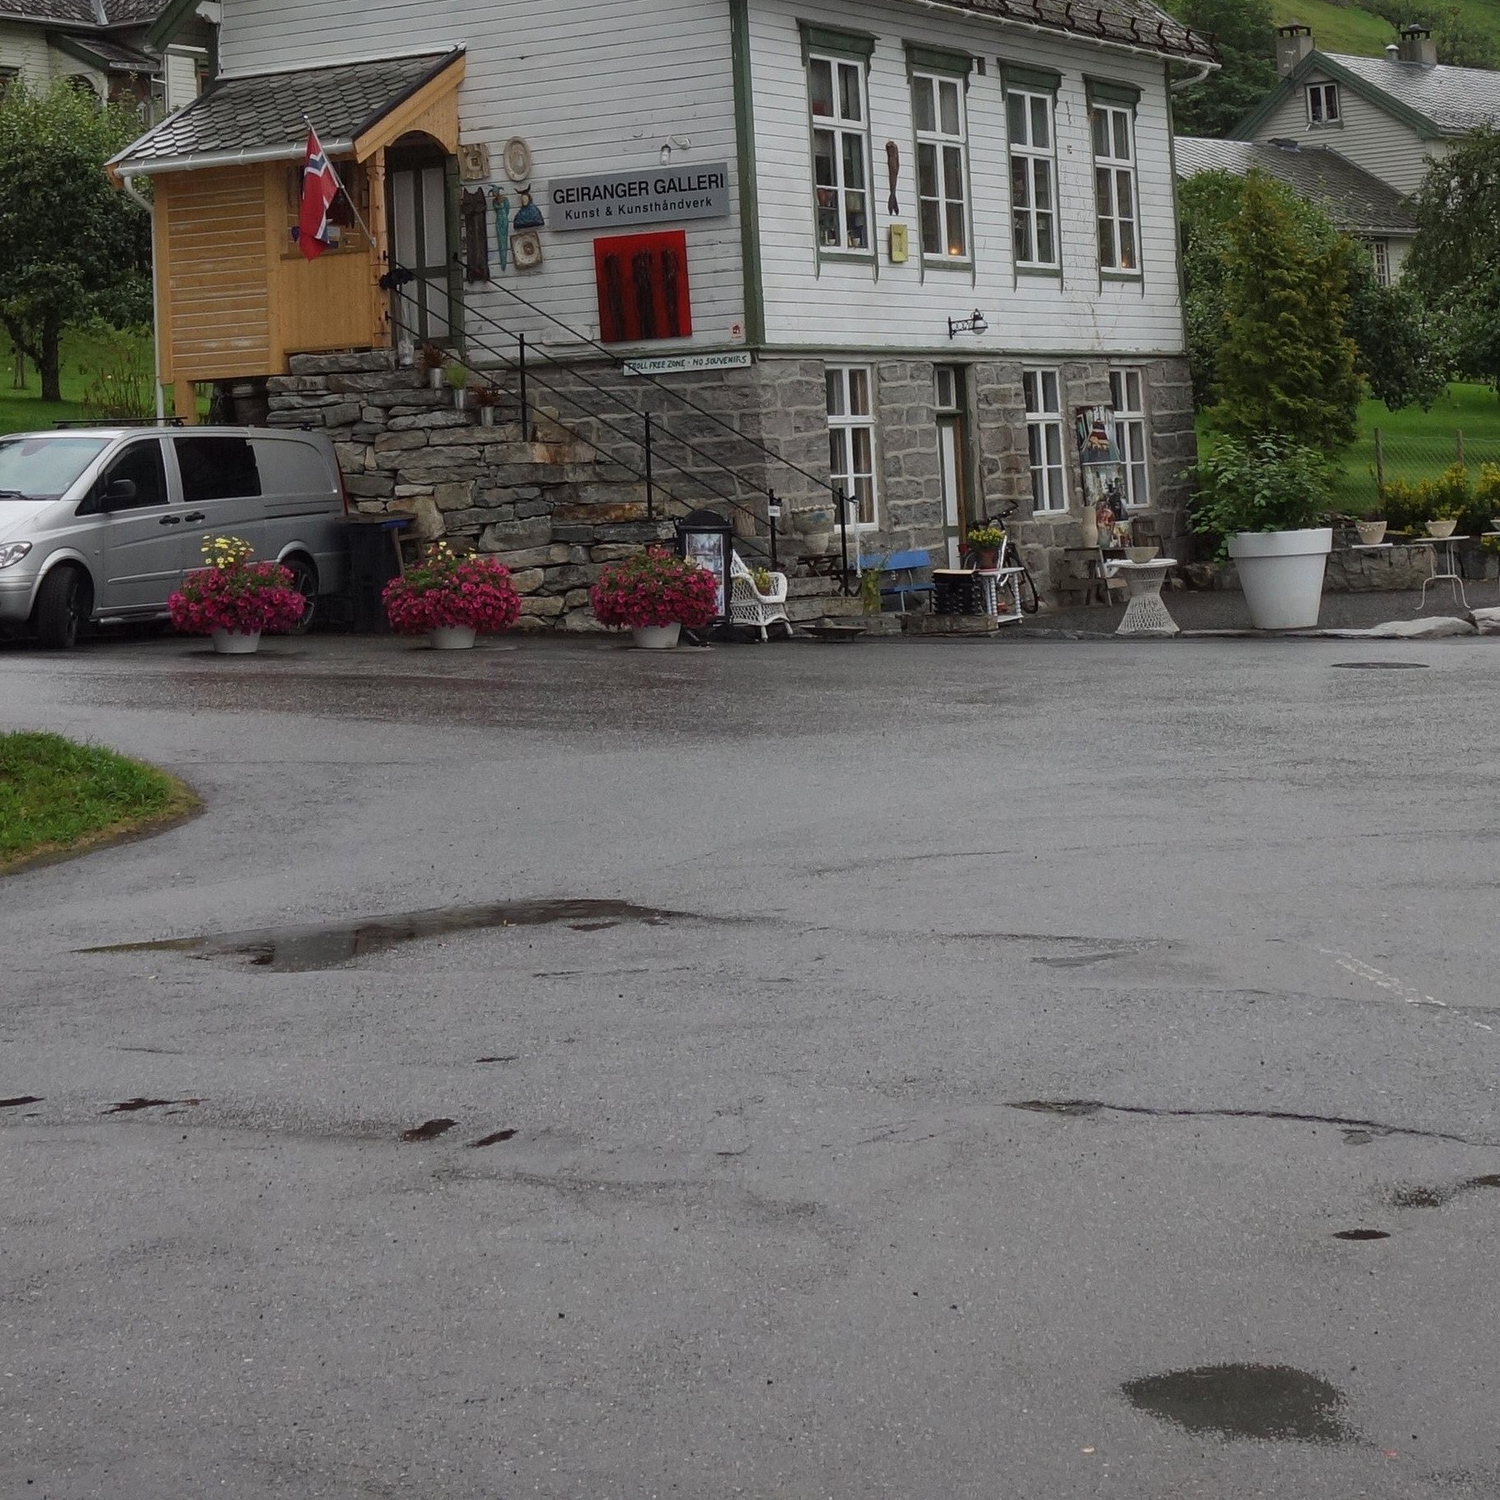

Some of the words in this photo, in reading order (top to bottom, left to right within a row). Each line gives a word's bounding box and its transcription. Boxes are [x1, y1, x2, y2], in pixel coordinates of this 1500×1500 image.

[553, 180, 649, 204] GEIRANGER
[654, 173, 724, 194] GALLERI
[565, 207, 600, 220] Kunst
[605, 206, 613, 216] &
[618, 197, 712, 215] Kunsthåndverk
[649, 360, 665, 370] FREE
[667, 359, 685, 368] ZONE
[693, 358, 703, 366] NO
[705, 355, 747, 365] SOUVENIRS
